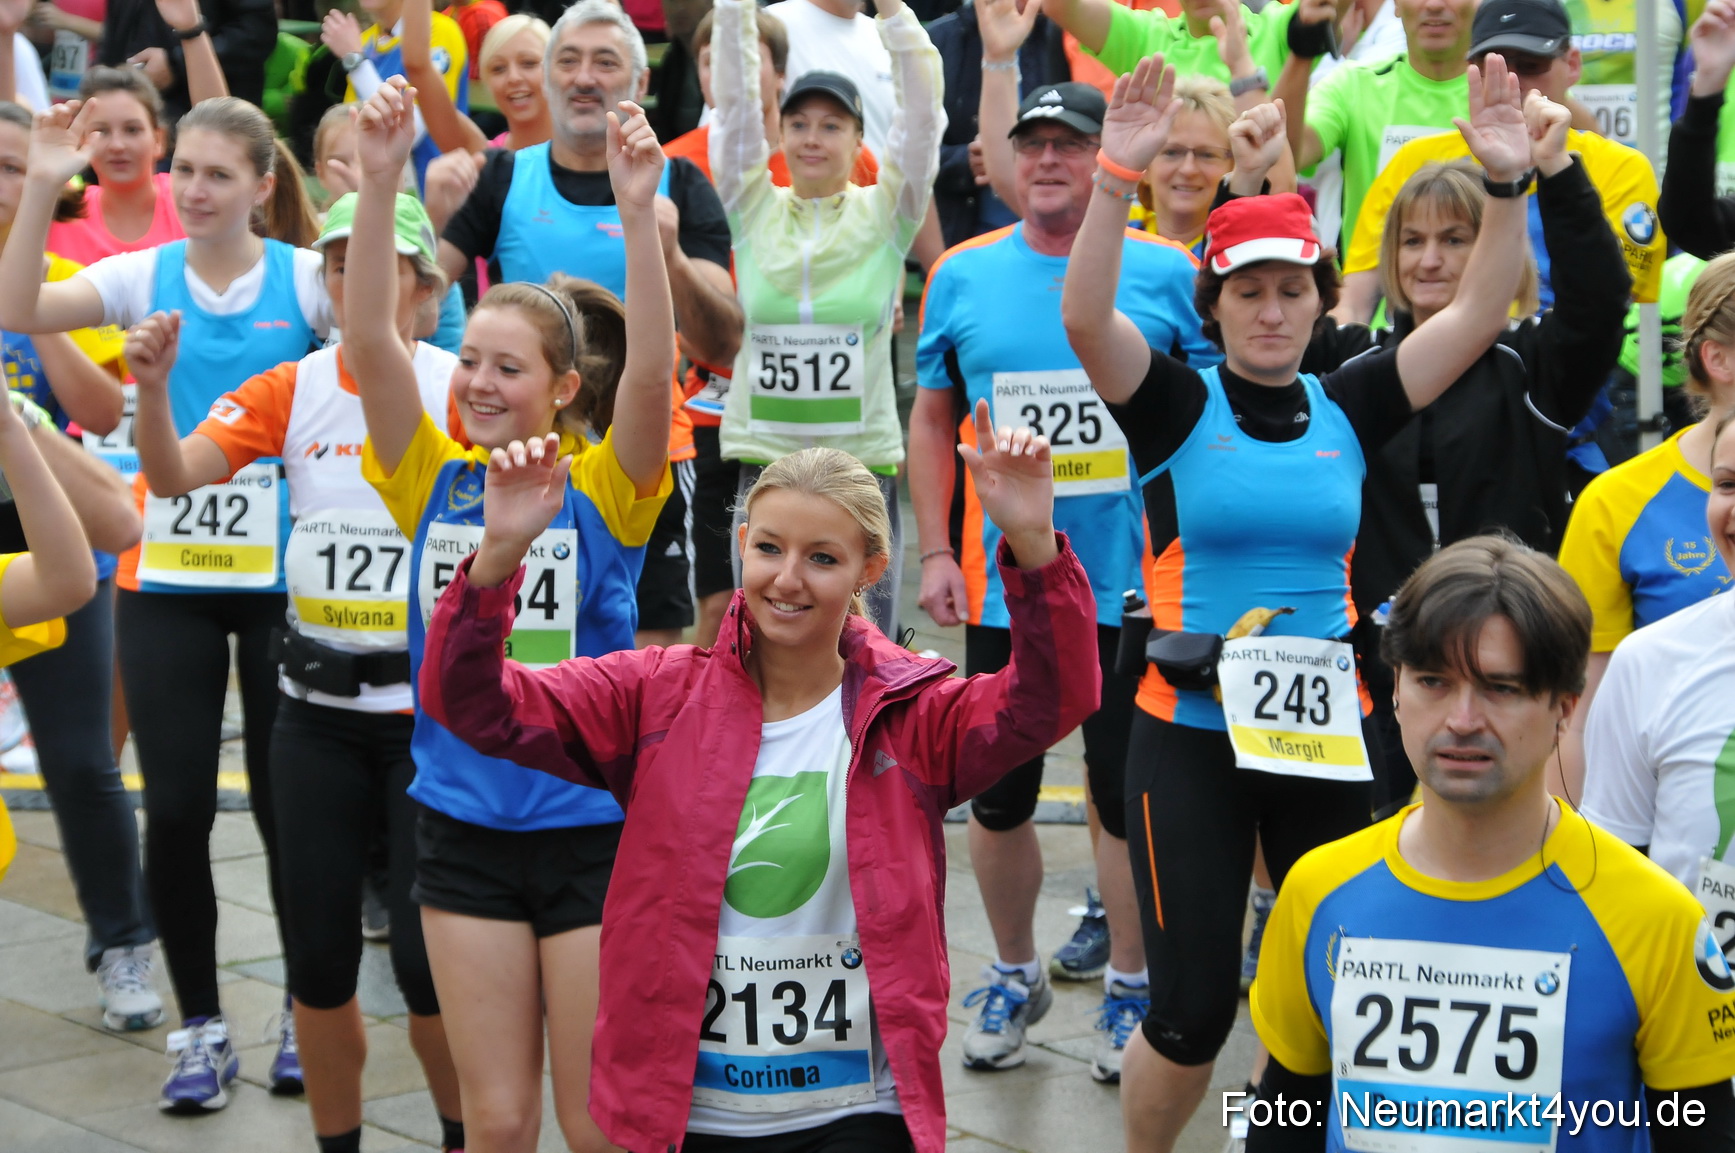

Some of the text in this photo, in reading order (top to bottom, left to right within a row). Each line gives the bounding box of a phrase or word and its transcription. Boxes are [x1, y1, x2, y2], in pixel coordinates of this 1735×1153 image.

[752, 333, 840, 345] PARTL Neumarkt
[759, 352, 851, 392] 5512
[996, 382, 1094, 396] PARTL Neumar
[1021, 401, 1101, 446] 325
[170, 492, 249, 537] 242
[340, 523, 403, 538] Neumark
[426, 537, 464, 554] PARTL
[1677, 550, 1707, 560] Jahre
[1683, 541, 1697, 549] 15
[181, 549, 233, 568] Corina
[316, 541, 404, 592] 127
[323, 604, 395, 628] Sylvana
[1221, 649, 1332, 668] PARTL Neumarkt
[1253, 669, 1331, 726] 243
[1268, 736, 1326, 761] Margit
[1702, 876, 1735, 900] PAR
[741, 953, 833, 972] Neumarkt
[1342, 960, 1524, 991] PARTL Neumarkt
[700, 979, 852, 1046] 2134
[1353, 993, 1539, 1081] 2575
[724, 1063, 821, 1089] Corina
